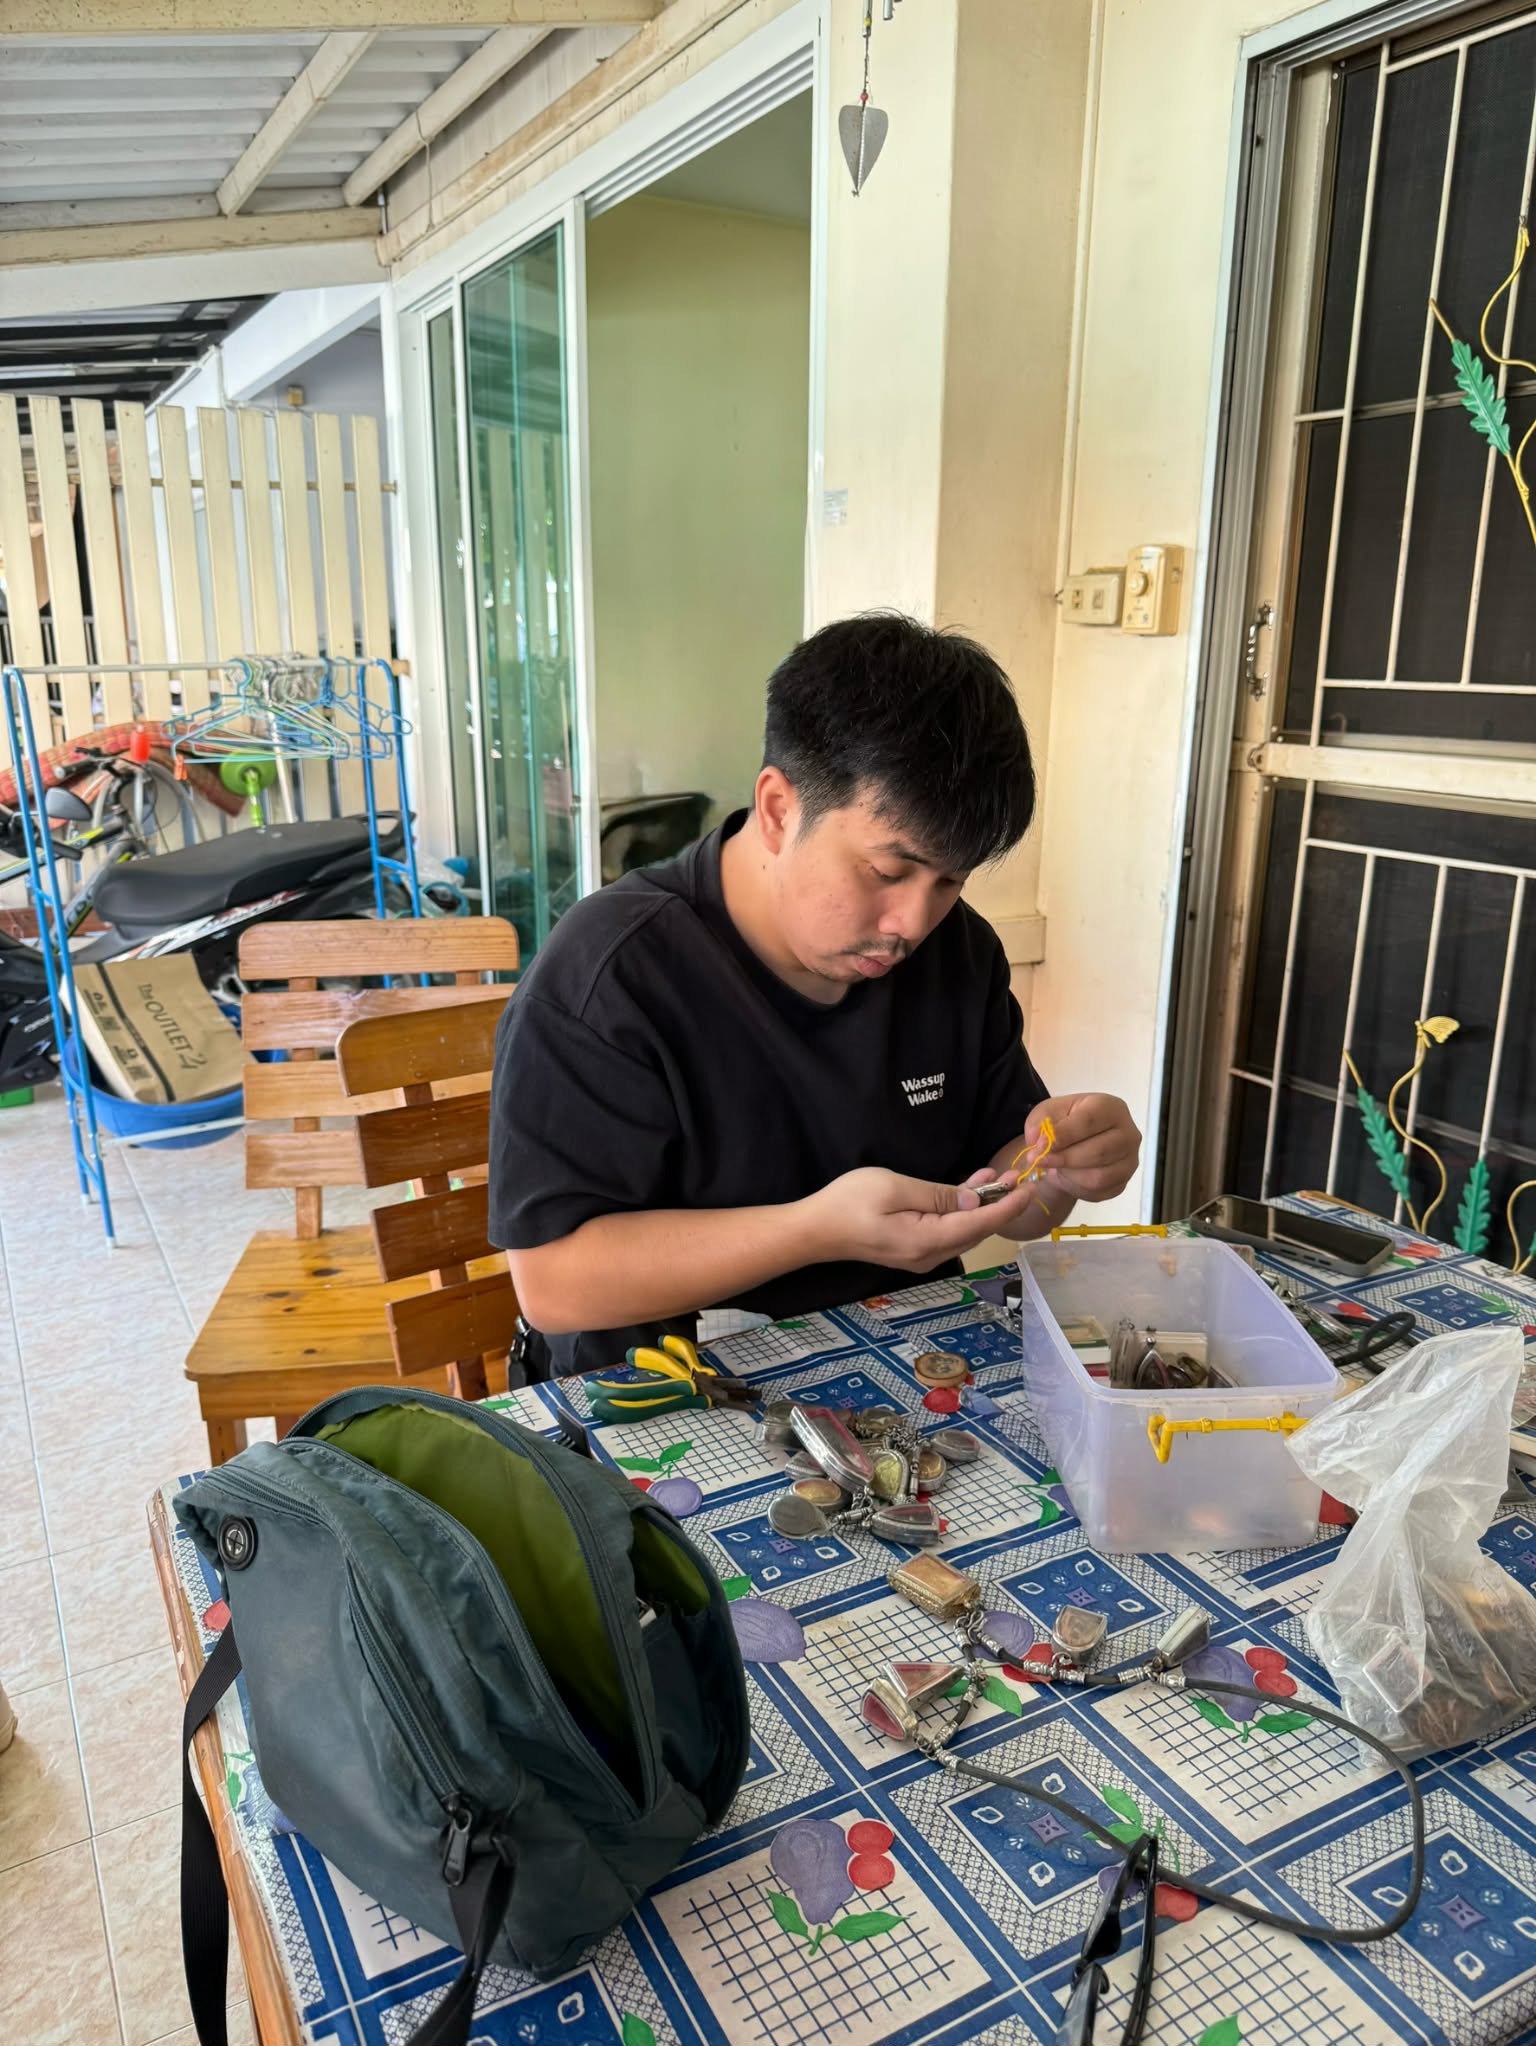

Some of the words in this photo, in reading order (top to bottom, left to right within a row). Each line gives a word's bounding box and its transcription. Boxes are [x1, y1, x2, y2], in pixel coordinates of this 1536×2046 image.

[145, 1001, 193, 1051] OUTLET
[901, 1072, 945, 1092] Wassup
[907, 1090, 938, 1107] Wake
